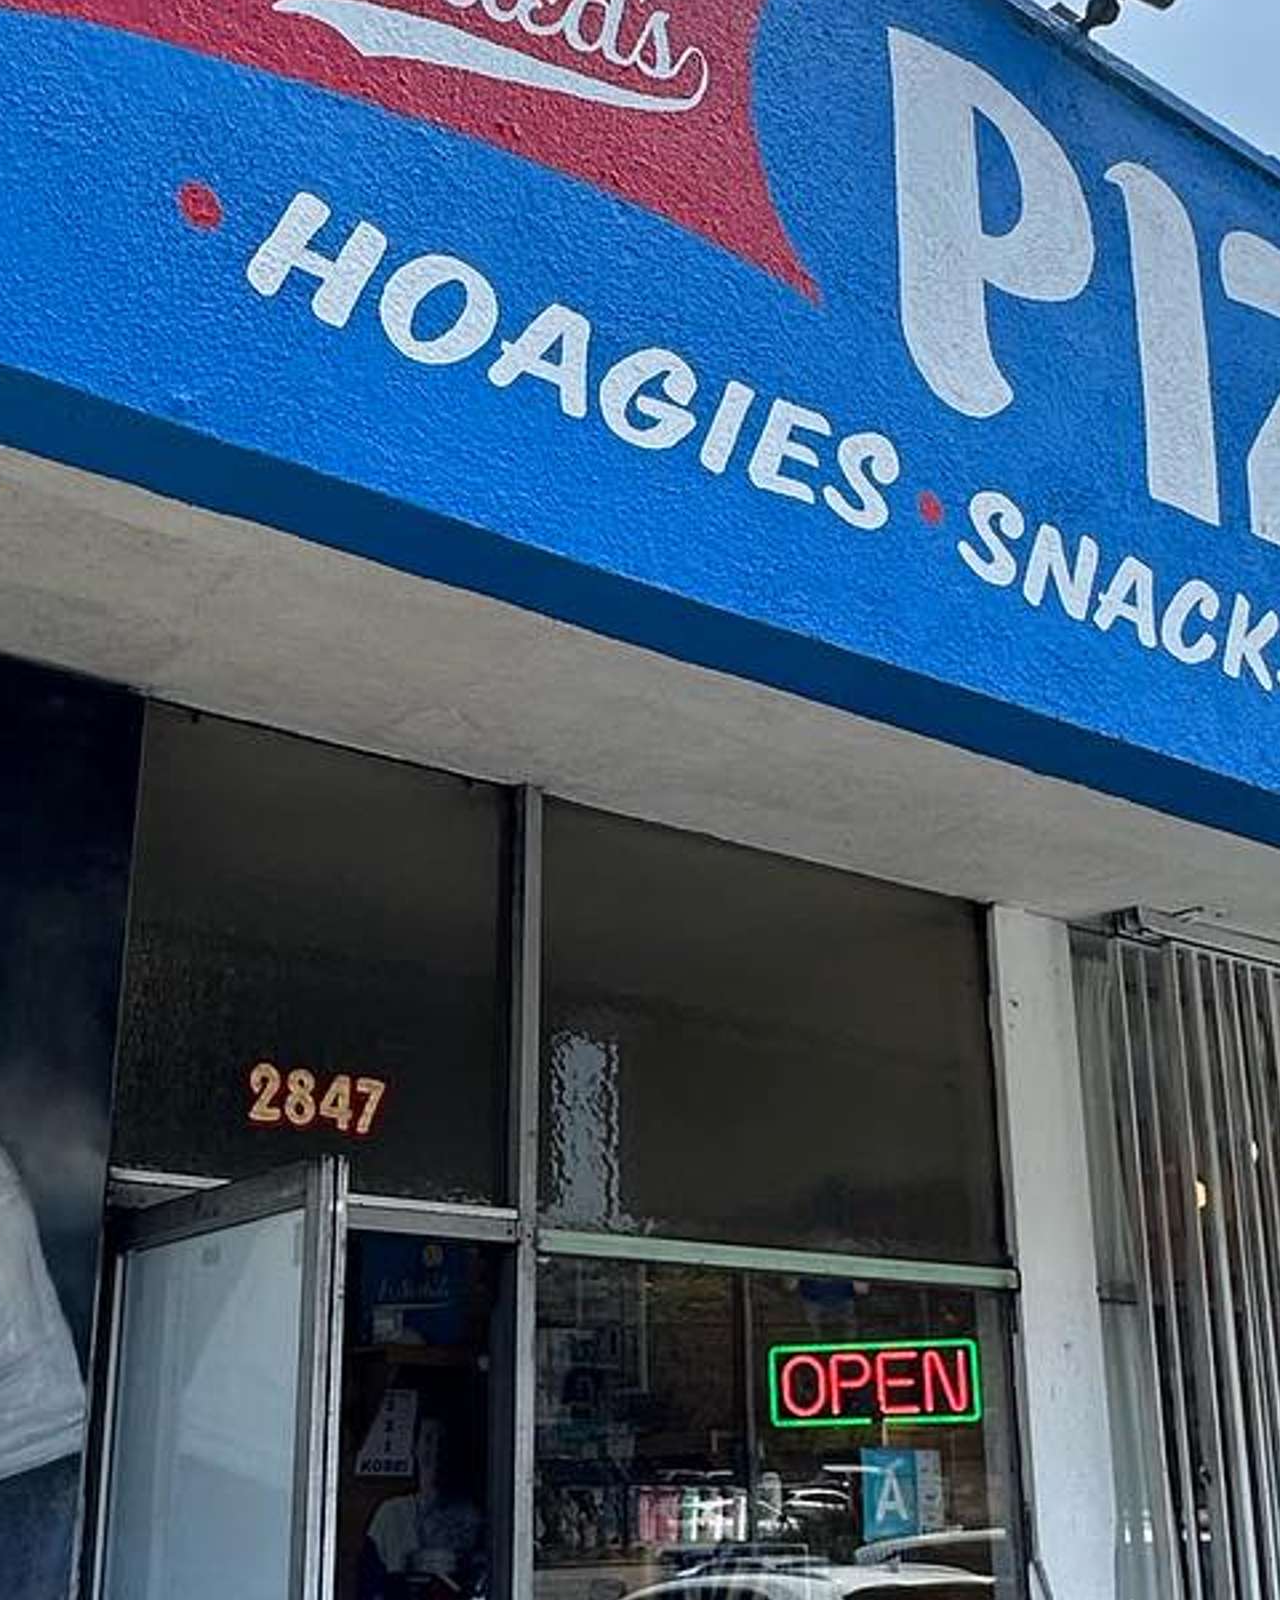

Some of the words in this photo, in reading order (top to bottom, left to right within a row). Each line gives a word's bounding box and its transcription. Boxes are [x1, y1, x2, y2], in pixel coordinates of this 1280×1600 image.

[245, 189, 902, 532] HOAGIES
[247, 1061, 387, 1134] 2847
[779, 1348, 969, 1419] OPEN
[874, 1468, 910, 1523] A
